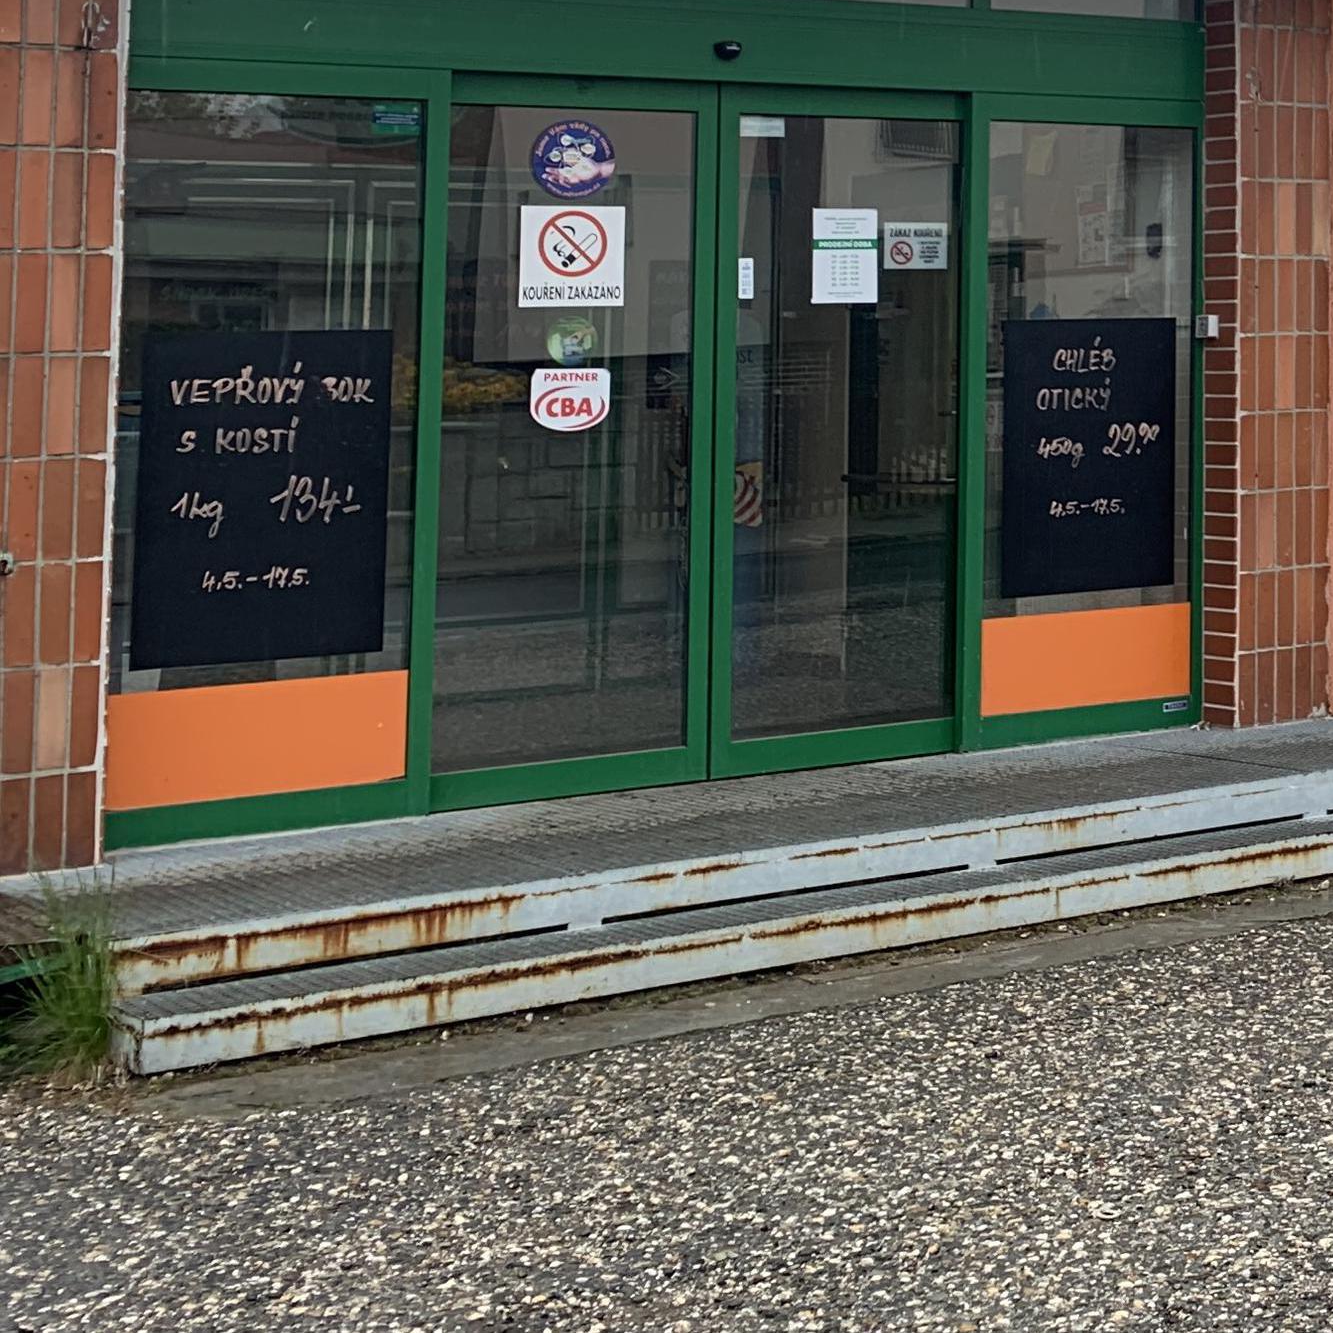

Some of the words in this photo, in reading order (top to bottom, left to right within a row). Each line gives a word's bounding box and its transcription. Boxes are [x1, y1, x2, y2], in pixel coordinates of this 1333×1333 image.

[889, 227, 912, 238] ZÁKAZ
[523, 281, 566, 301] KOUŘENÍ
[567, 281, 621, 300] ZAKÁZÁNO
[1053, 336, 1117, 373] CHLÉB
[170, 361, 305, 406] VEPŘOVÝ
[544, 372, 599, 382] PARTNER
[545, 397, 593, 418] CBA
[1036, 377, 1111, 412] OTICKÝ
[214, 415, 300, 455] KOSTÍ
[1036, 436, 1086, 468] 450g
[170, 491, 224, 539] 1kg
